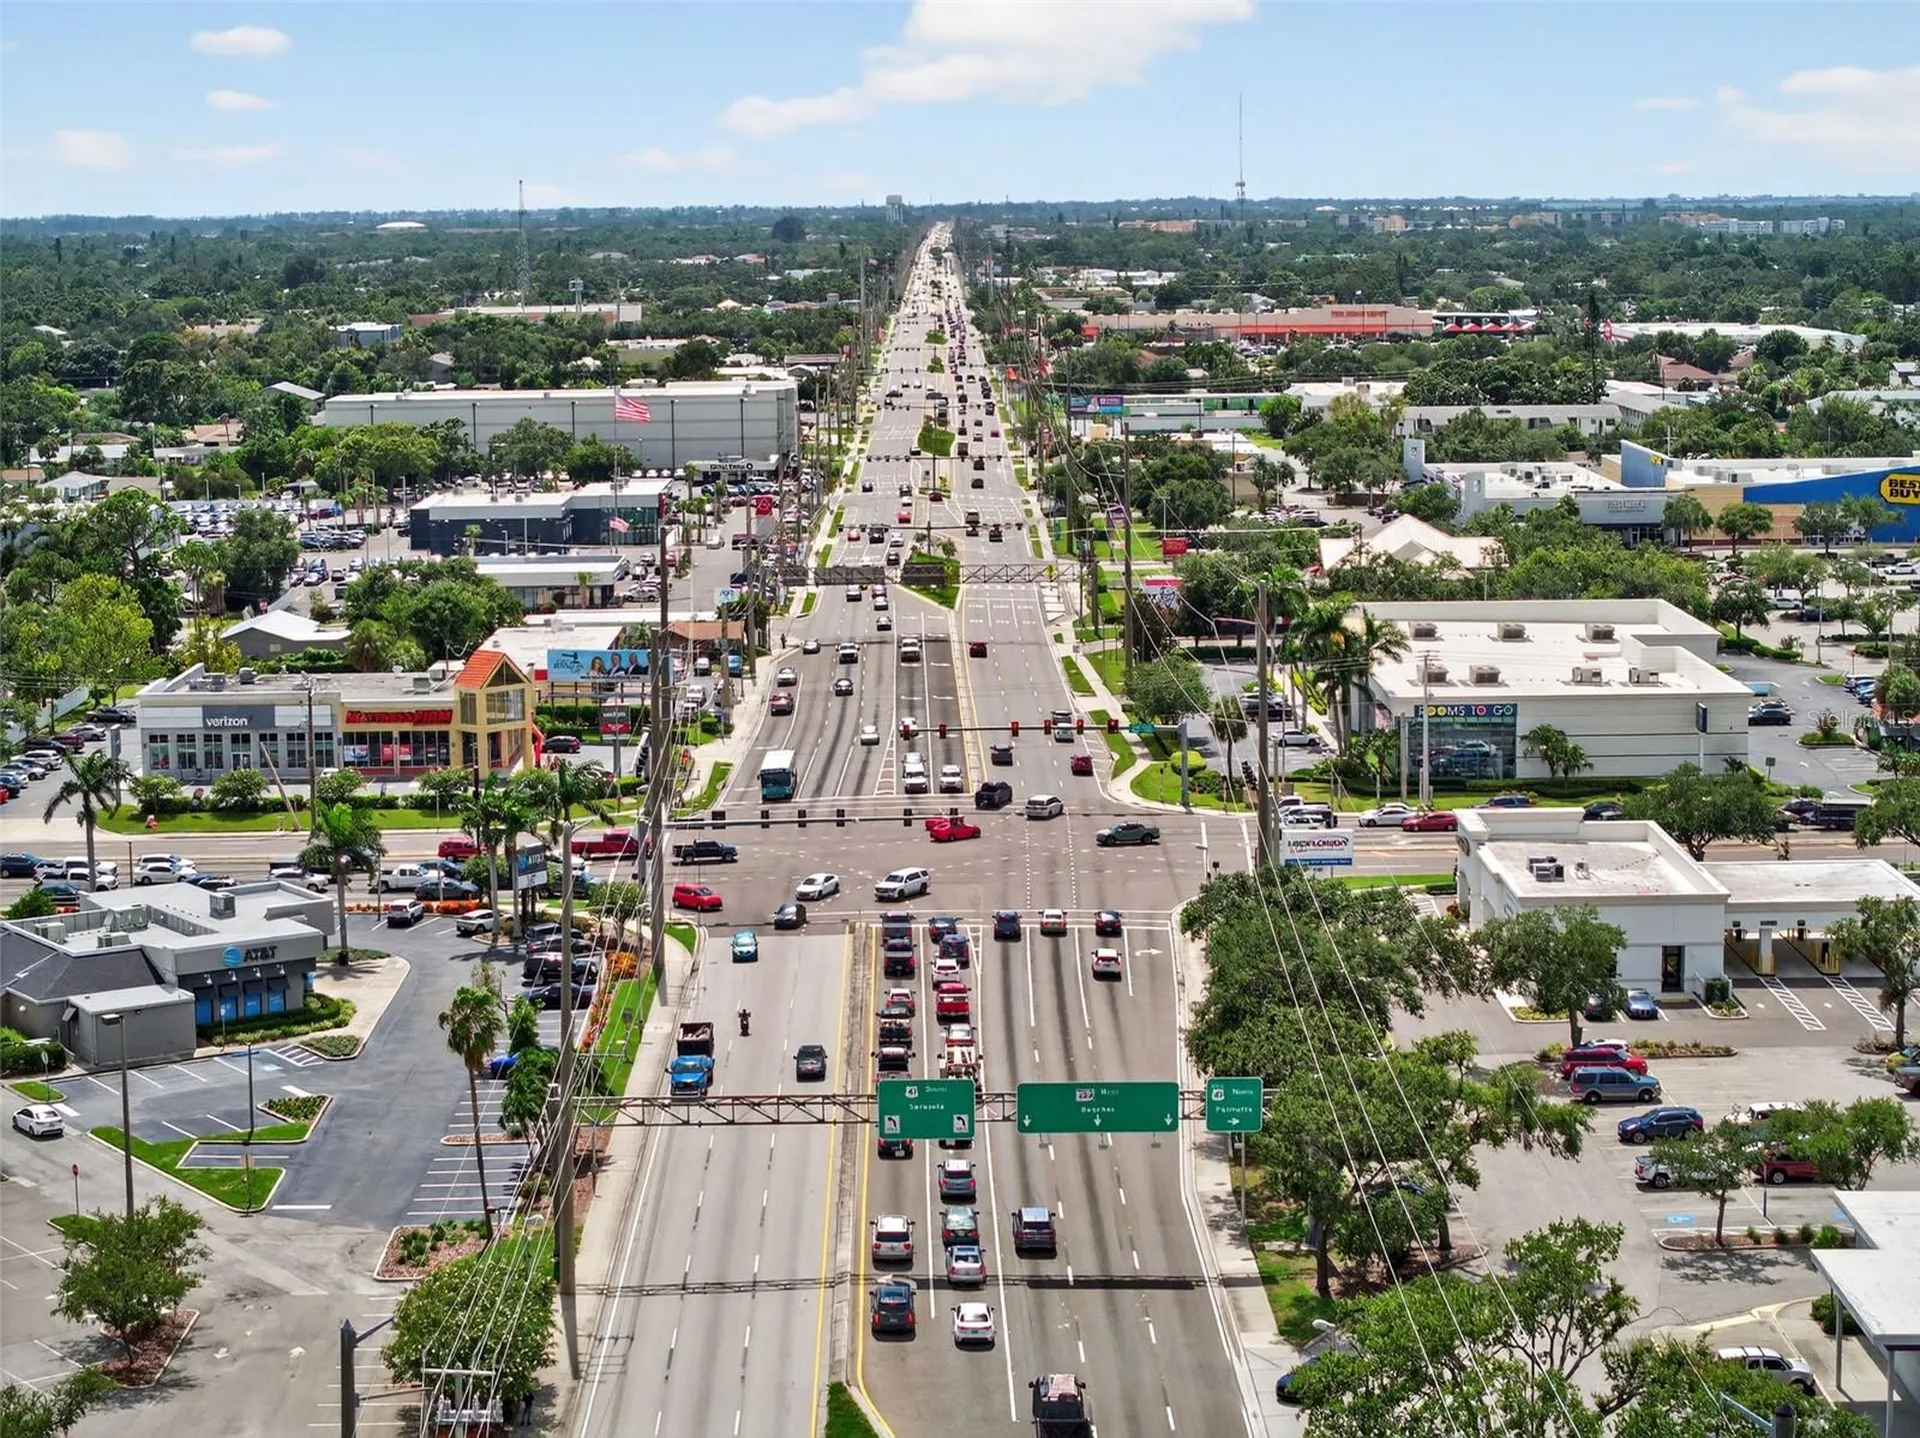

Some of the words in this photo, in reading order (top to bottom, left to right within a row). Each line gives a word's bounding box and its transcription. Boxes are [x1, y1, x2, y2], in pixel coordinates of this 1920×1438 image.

[1472, 704, 1487, 716] TO
[1493, 704, 1514, 716] GO
[205, 715, 248, 727] verizon
[243, 945, 278, 962] AT&T
